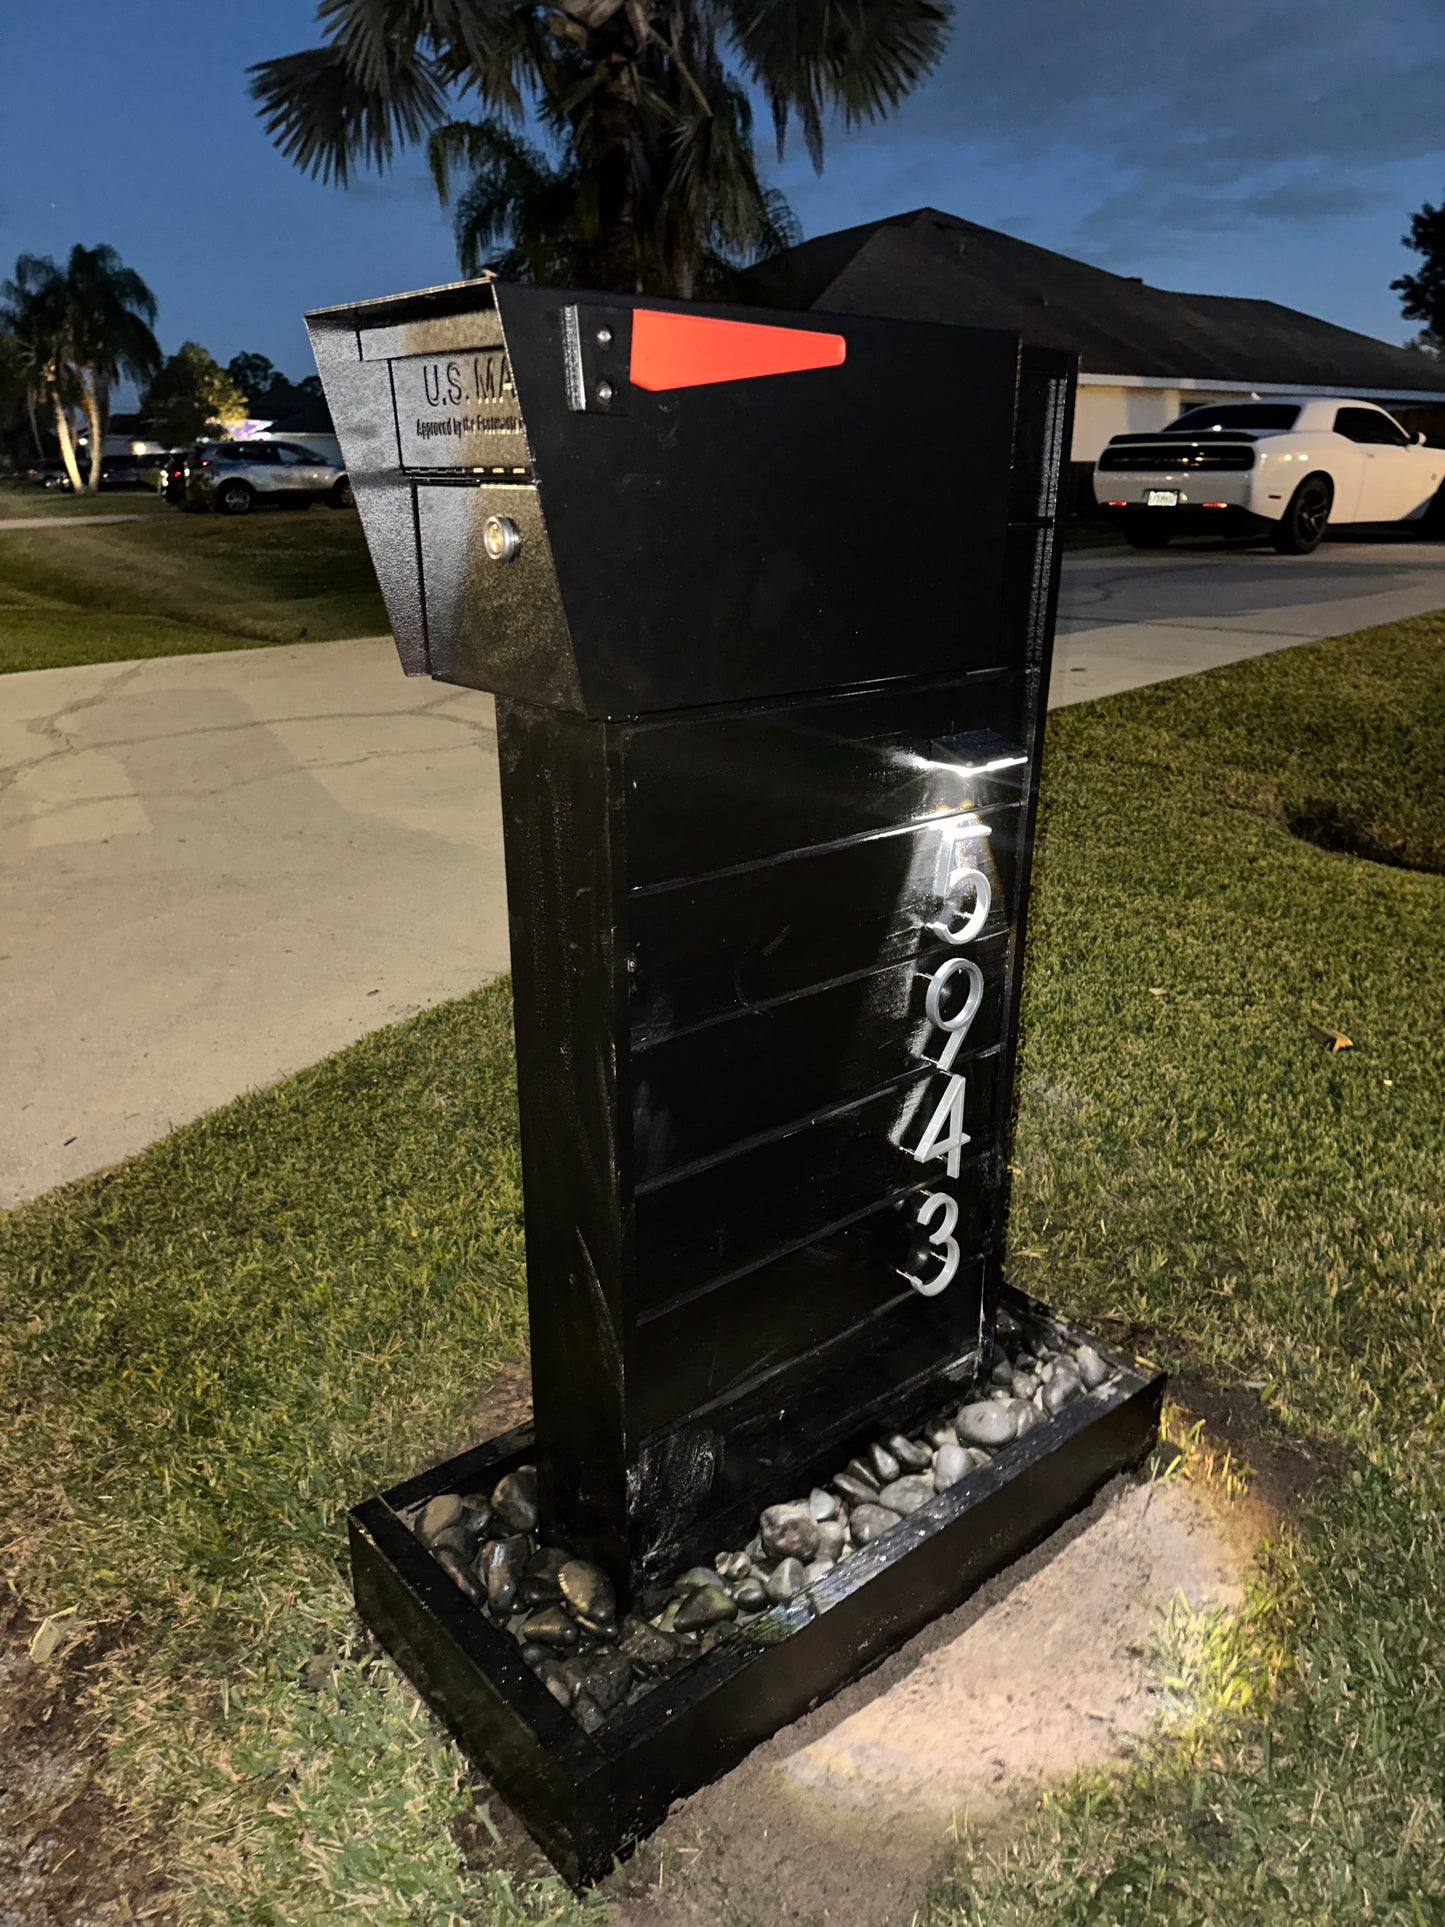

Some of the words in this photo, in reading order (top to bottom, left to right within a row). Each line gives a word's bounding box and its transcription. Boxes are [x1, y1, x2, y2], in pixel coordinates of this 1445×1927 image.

[423, 361, 469, 407] U.S.
[416, 417, 452, 440] Approved
[452, 416, 462, 439] by
